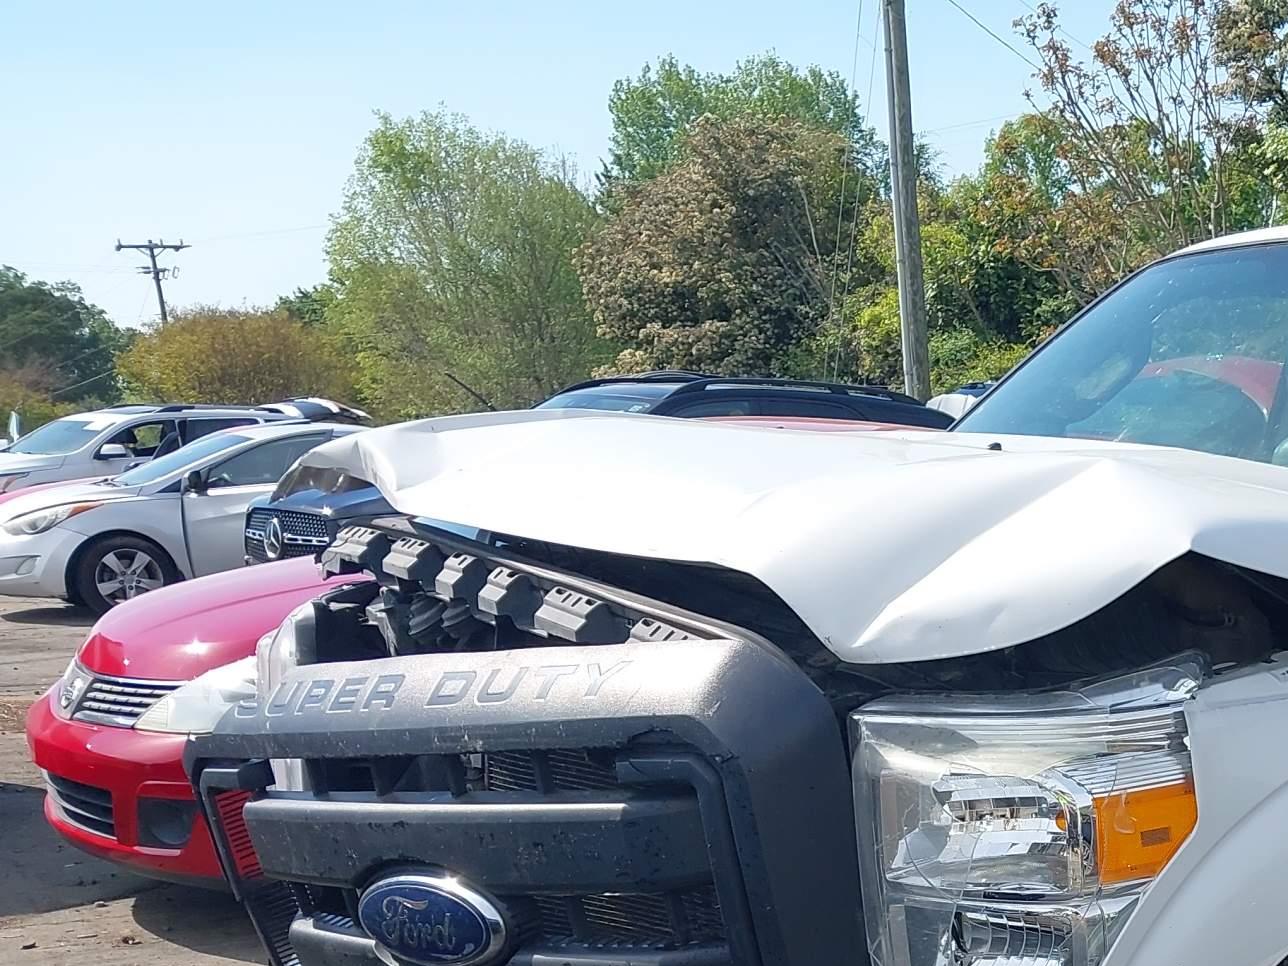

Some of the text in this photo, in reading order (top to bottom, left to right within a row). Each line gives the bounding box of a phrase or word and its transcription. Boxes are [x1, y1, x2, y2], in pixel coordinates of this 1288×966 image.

[234, 659, 634, 719] SUPER DUTY
[381, 895, 456, 951] Ford
